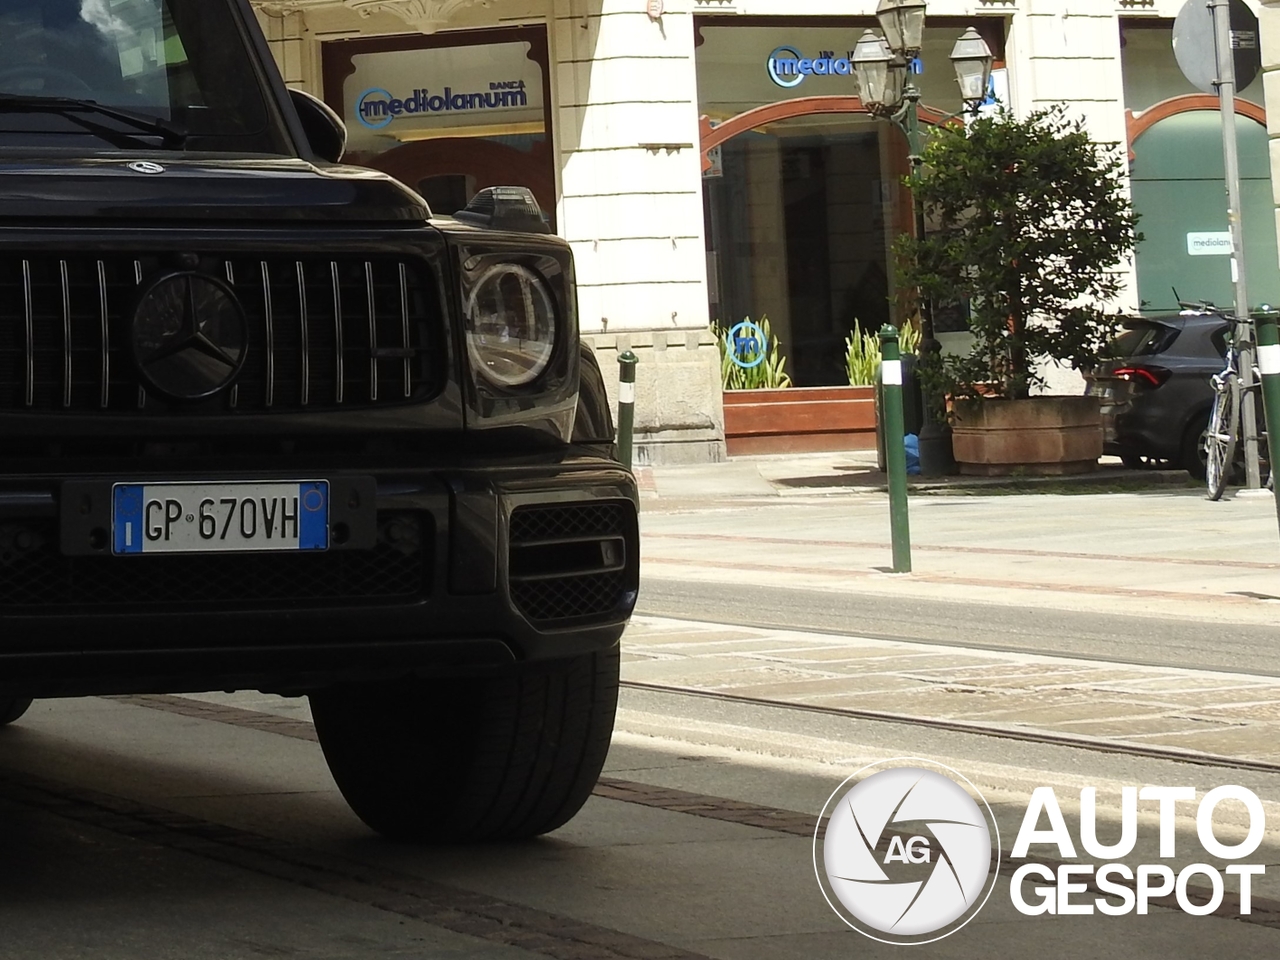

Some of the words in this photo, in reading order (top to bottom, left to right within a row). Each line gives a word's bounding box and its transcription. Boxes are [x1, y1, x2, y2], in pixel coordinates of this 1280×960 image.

[489, 80, 526, 91] BANCA
[362, 86, 528, 117] mediolanum
[1193, 237, 1231, 247] mediolan
